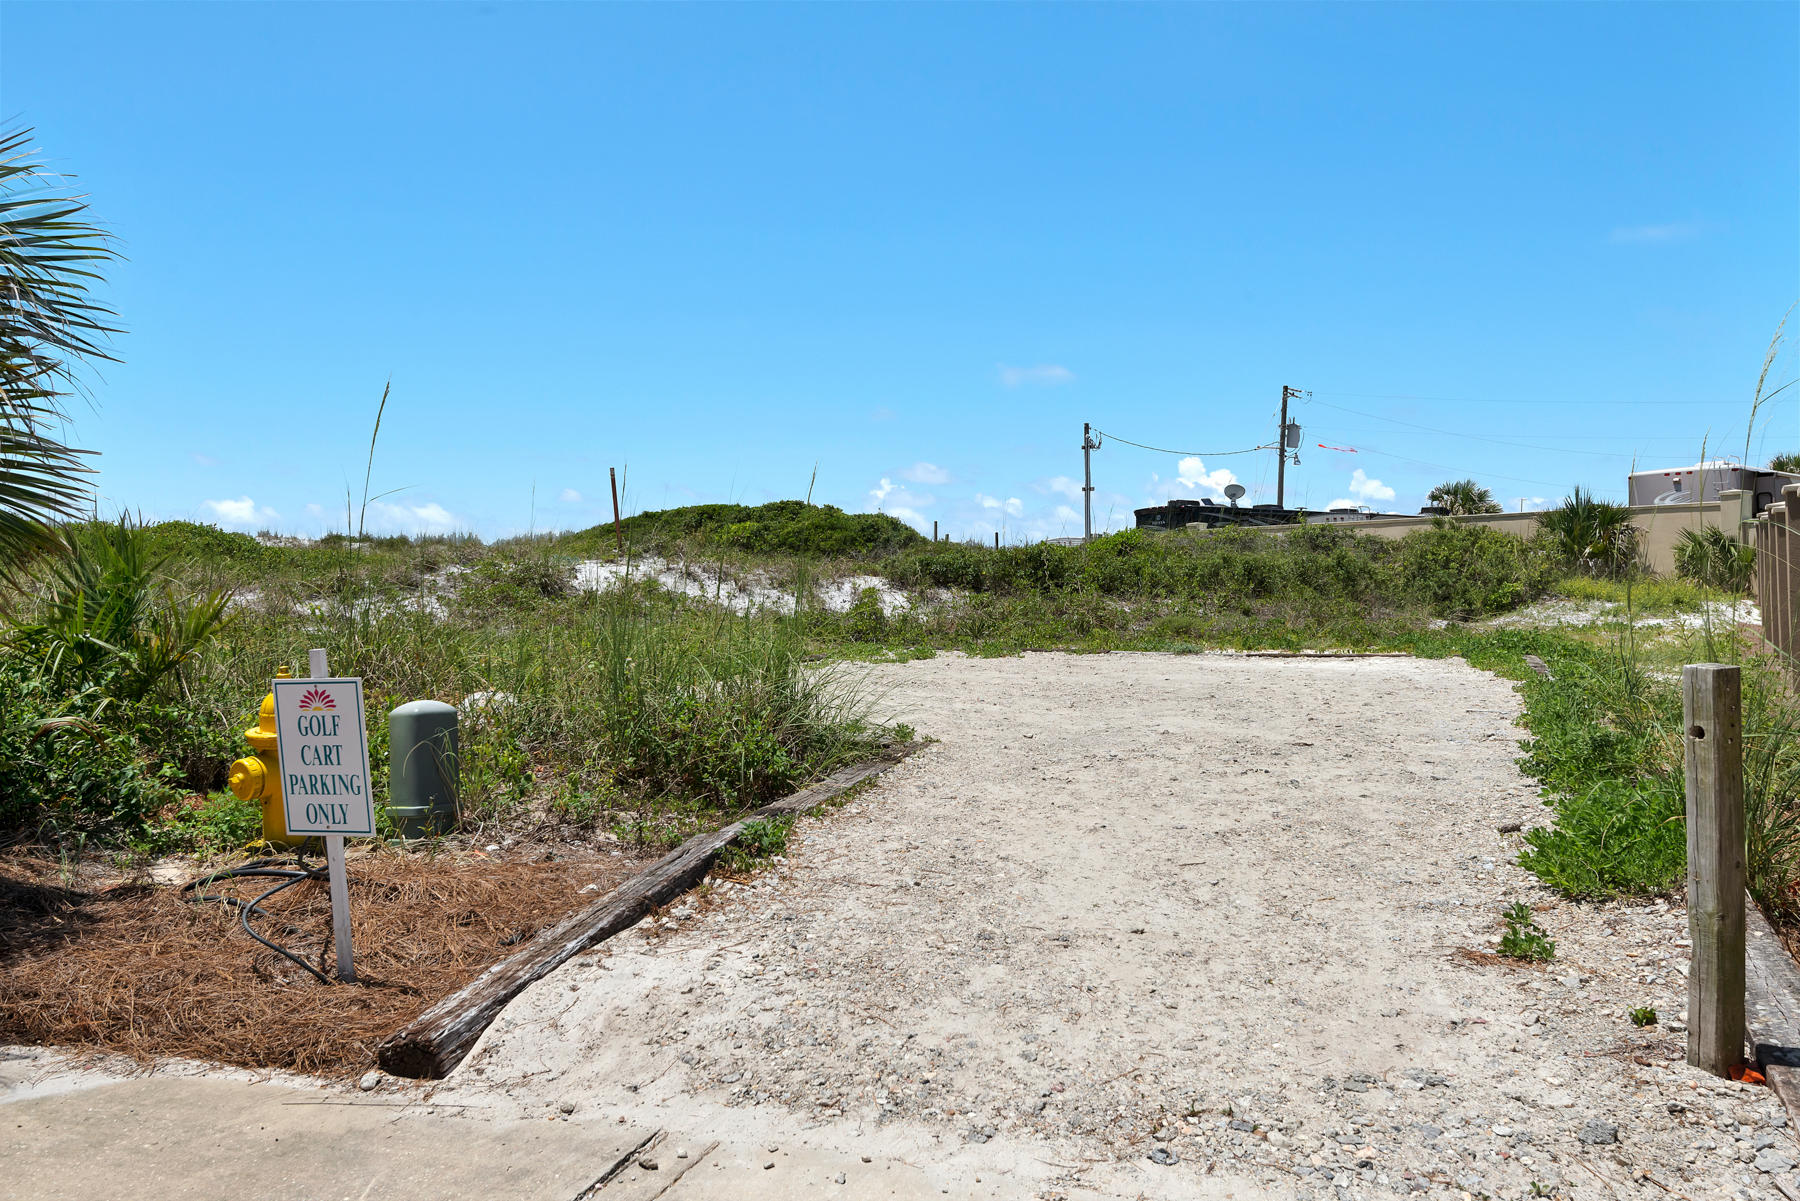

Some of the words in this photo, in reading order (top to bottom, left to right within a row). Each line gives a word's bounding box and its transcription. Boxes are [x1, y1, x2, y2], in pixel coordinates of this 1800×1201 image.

[297, 715, 340, 737] GOLF
[300, 744, 342, 766] CART
[289, 774, 361, 796] PARKING
[306, 803, 349, 825] ONLY
